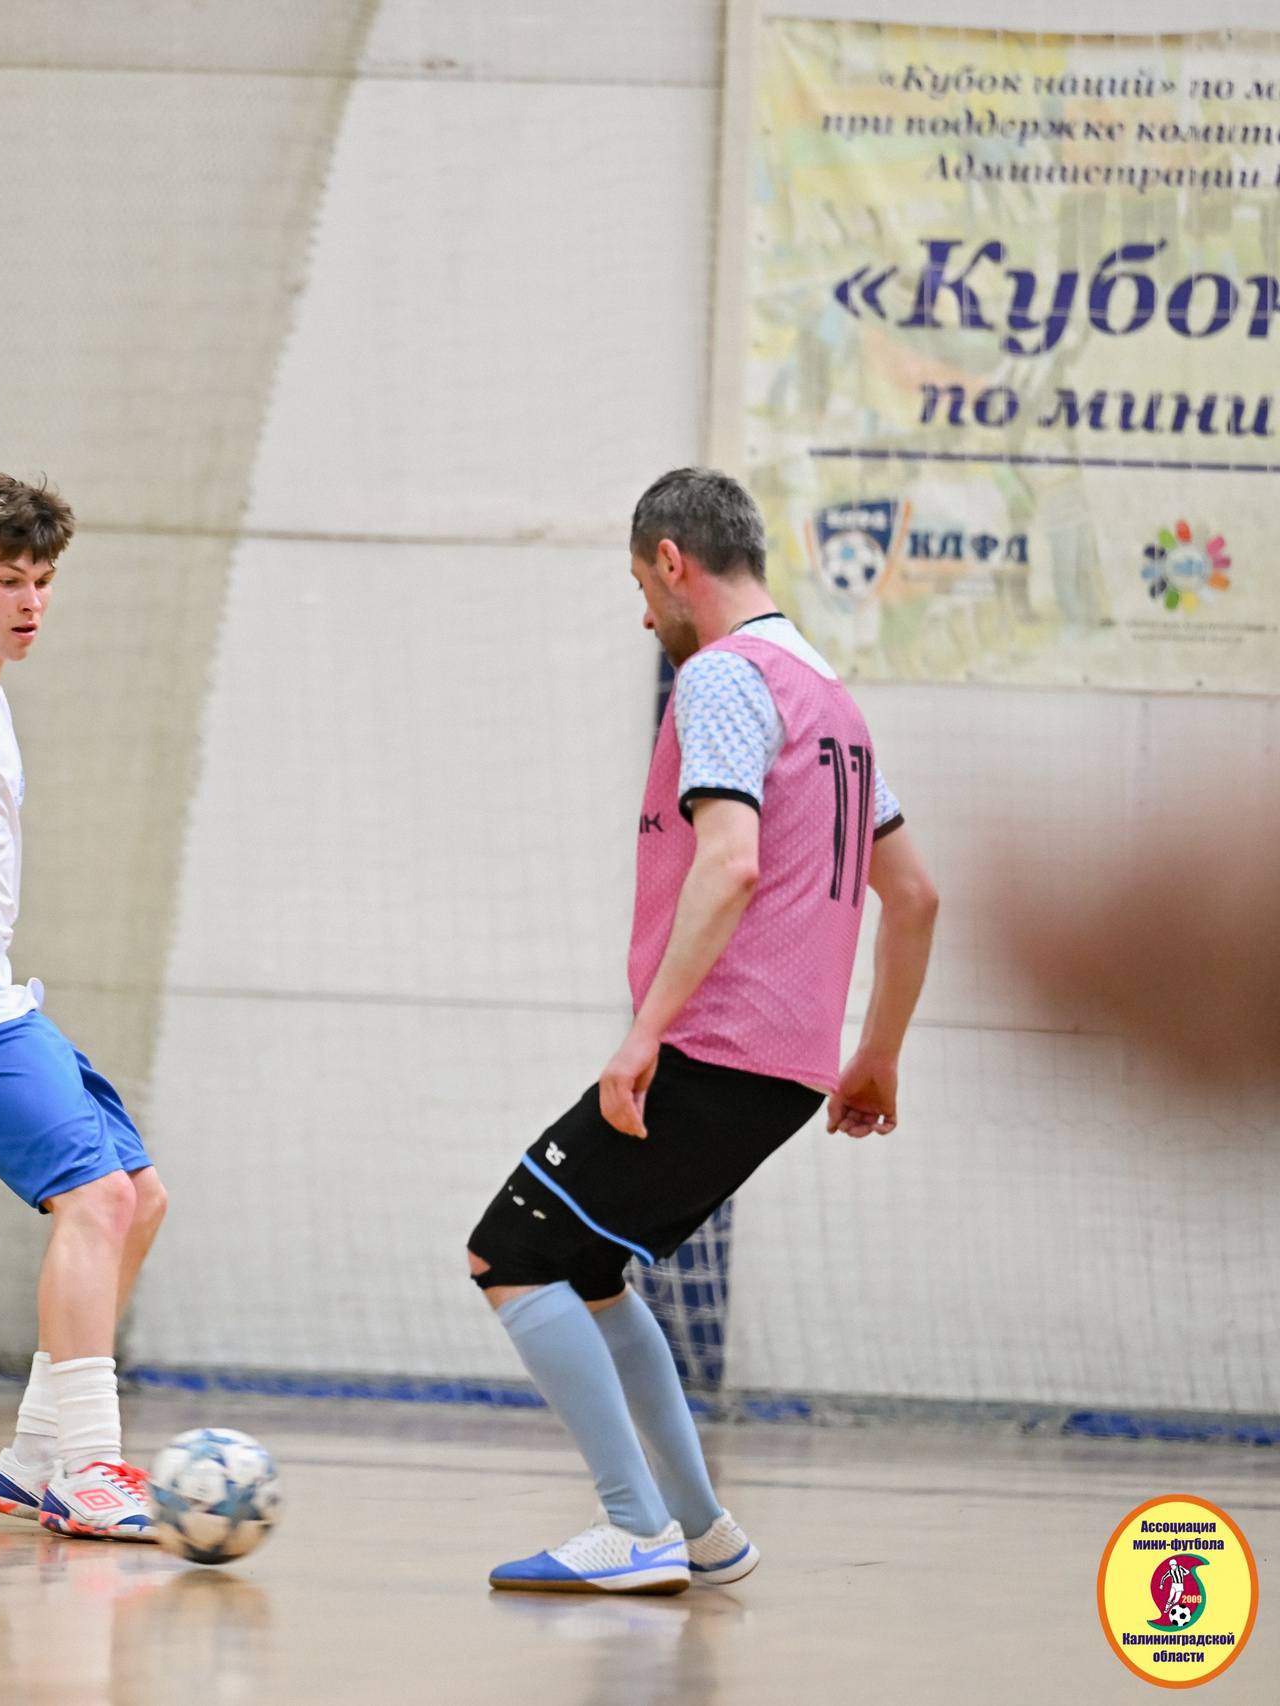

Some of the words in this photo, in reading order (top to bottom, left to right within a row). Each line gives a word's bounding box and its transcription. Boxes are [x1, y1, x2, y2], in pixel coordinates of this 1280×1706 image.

[880, 64, 1023, 99] «Кубок
[1189, 76, 1234, 99] по
[820, 110, 894, 141] при
[904, 108, 1124, 149] поддержке
[1135, 121, 1280, 147] комит
[925, 154, 1261, 194] Администрации
[920, 382, 1021, 429] по
[818, 737, 872, 908] 11
